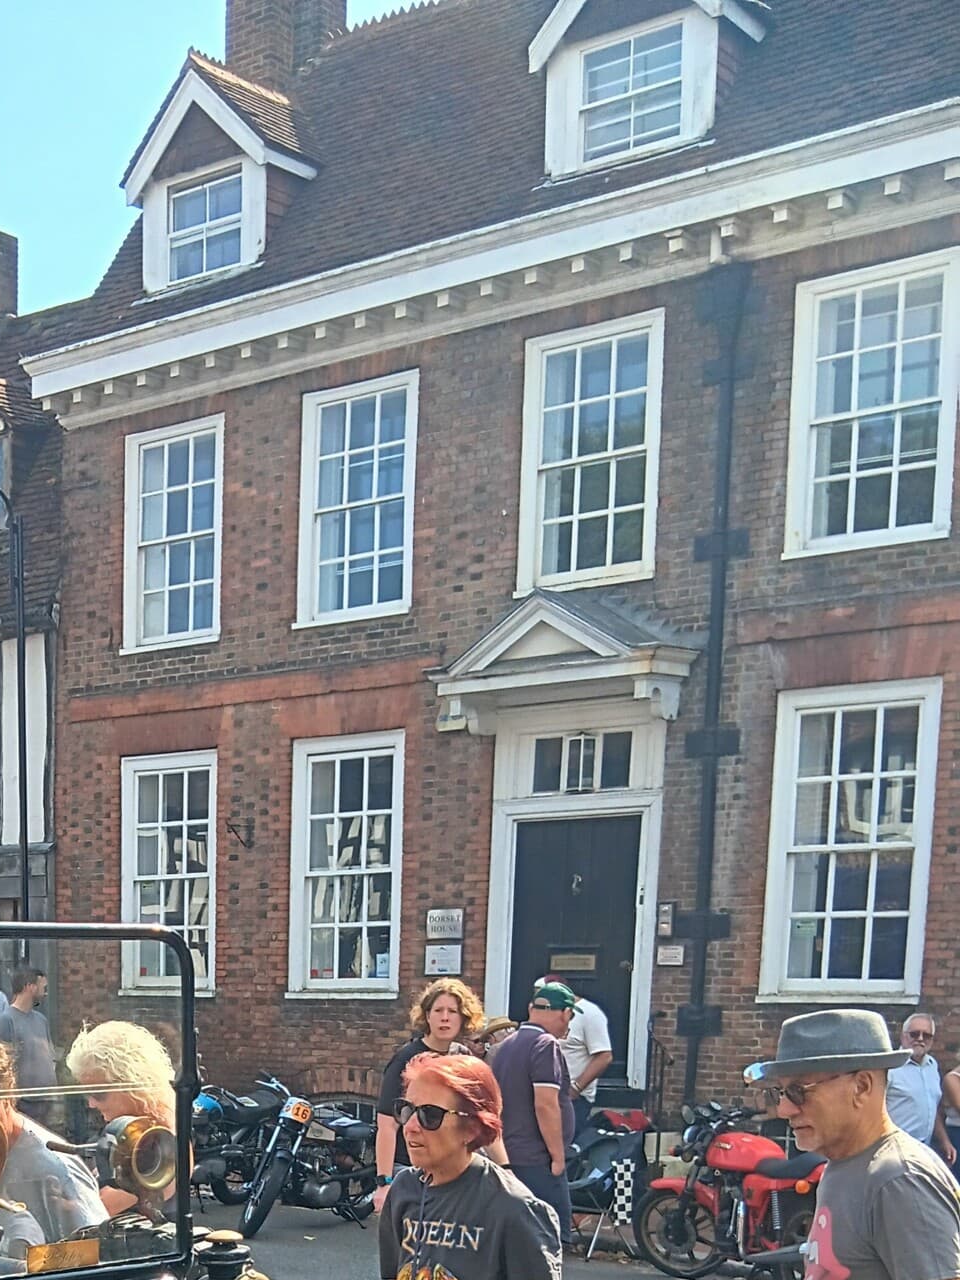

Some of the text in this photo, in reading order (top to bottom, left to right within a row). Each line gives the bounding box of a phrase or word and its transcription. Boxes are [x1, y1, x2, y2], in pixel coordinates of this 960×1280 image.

[429, 914, 461, 923] DORSET
[431, 925, 458, 933] HOUSE
[294, 1106, 309, 1120] 16
[401, 1217, 484, 1256] QUEEN
